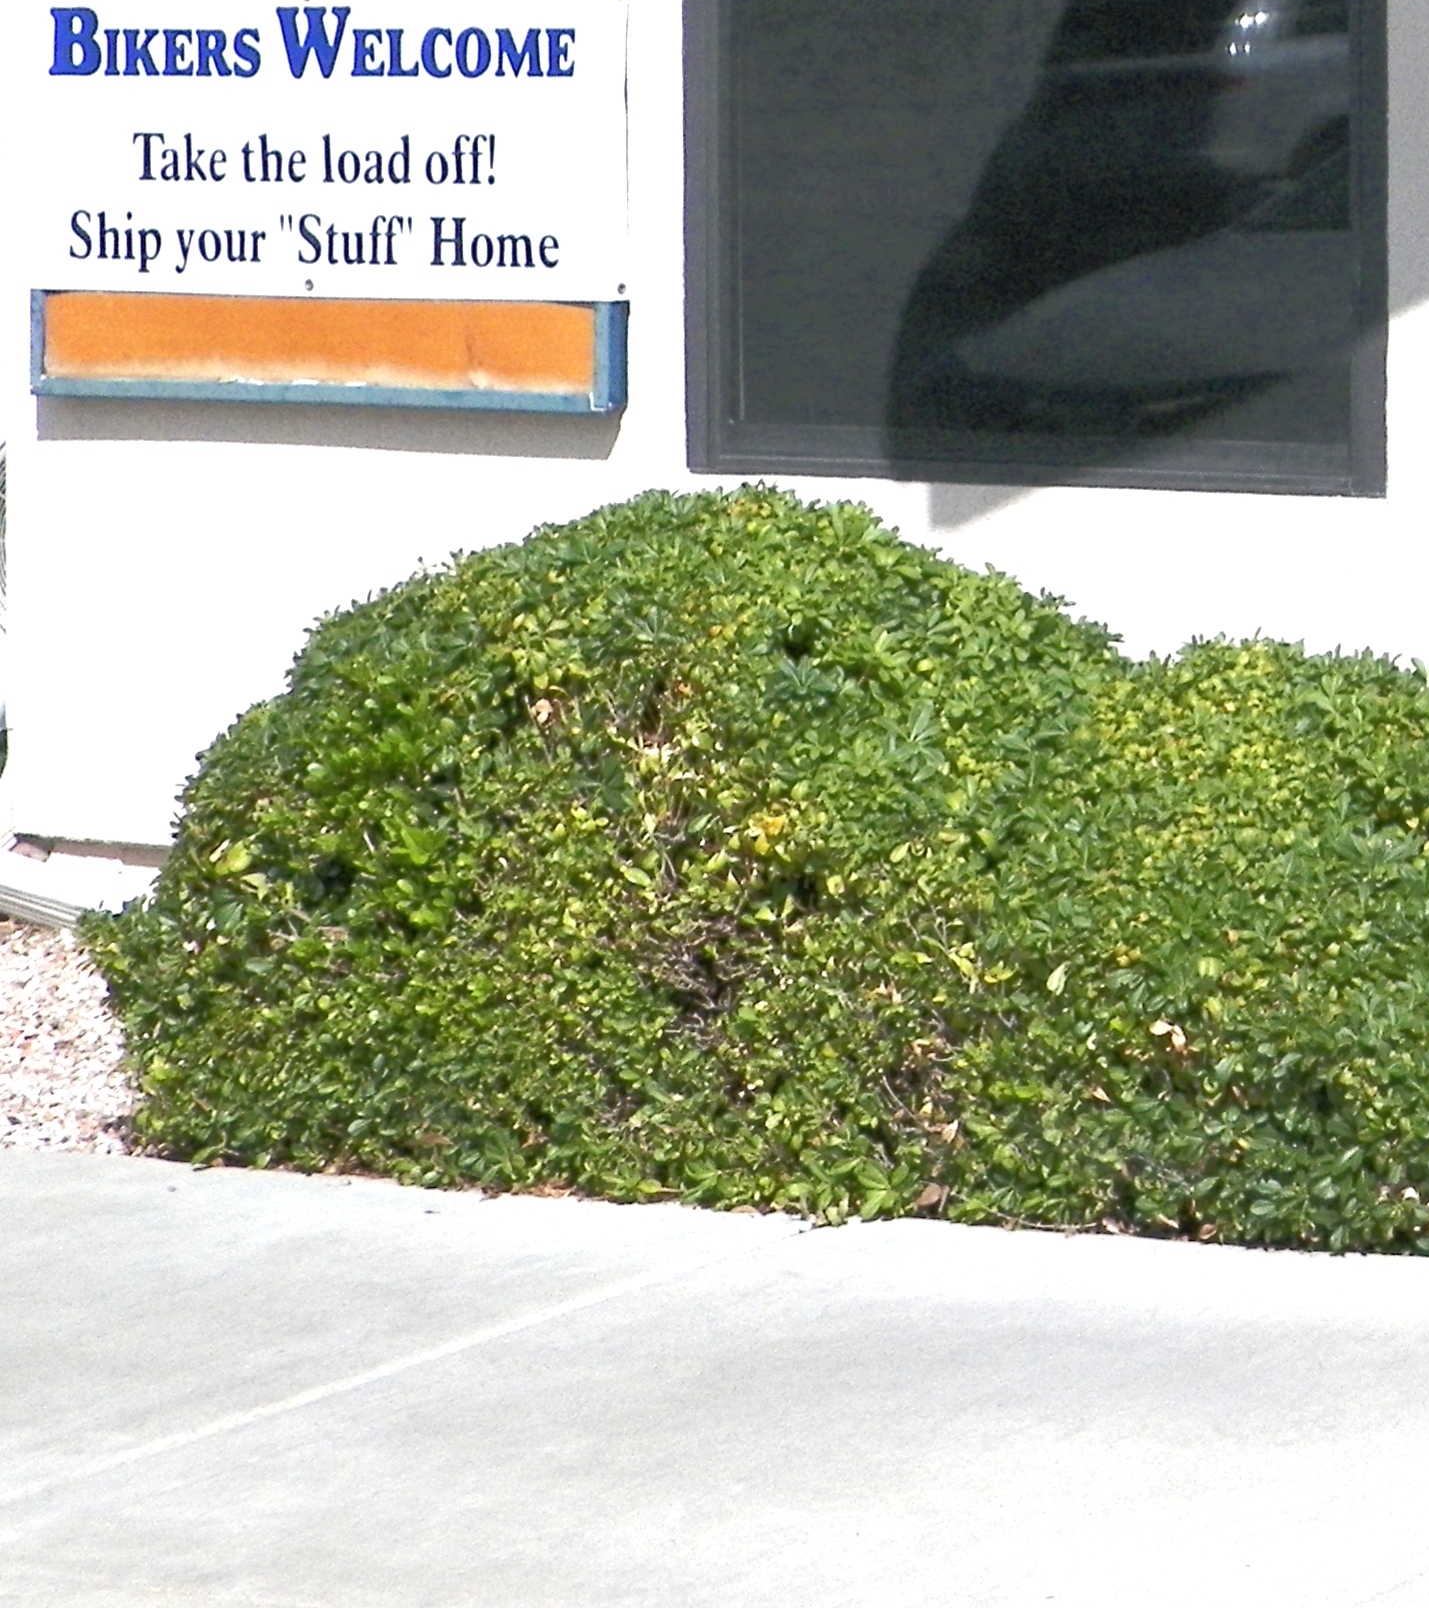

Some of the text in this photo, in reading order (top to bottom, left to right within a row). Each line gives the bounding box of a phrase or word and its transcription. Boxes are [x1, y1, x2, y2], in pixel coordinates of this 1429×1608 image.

[48, 6, 576, 79] BIKERS WELCOME
[133, 132, 497, 185] Take the load off!
[69, 210, 559, 274] Ship your "Stuff" Home
